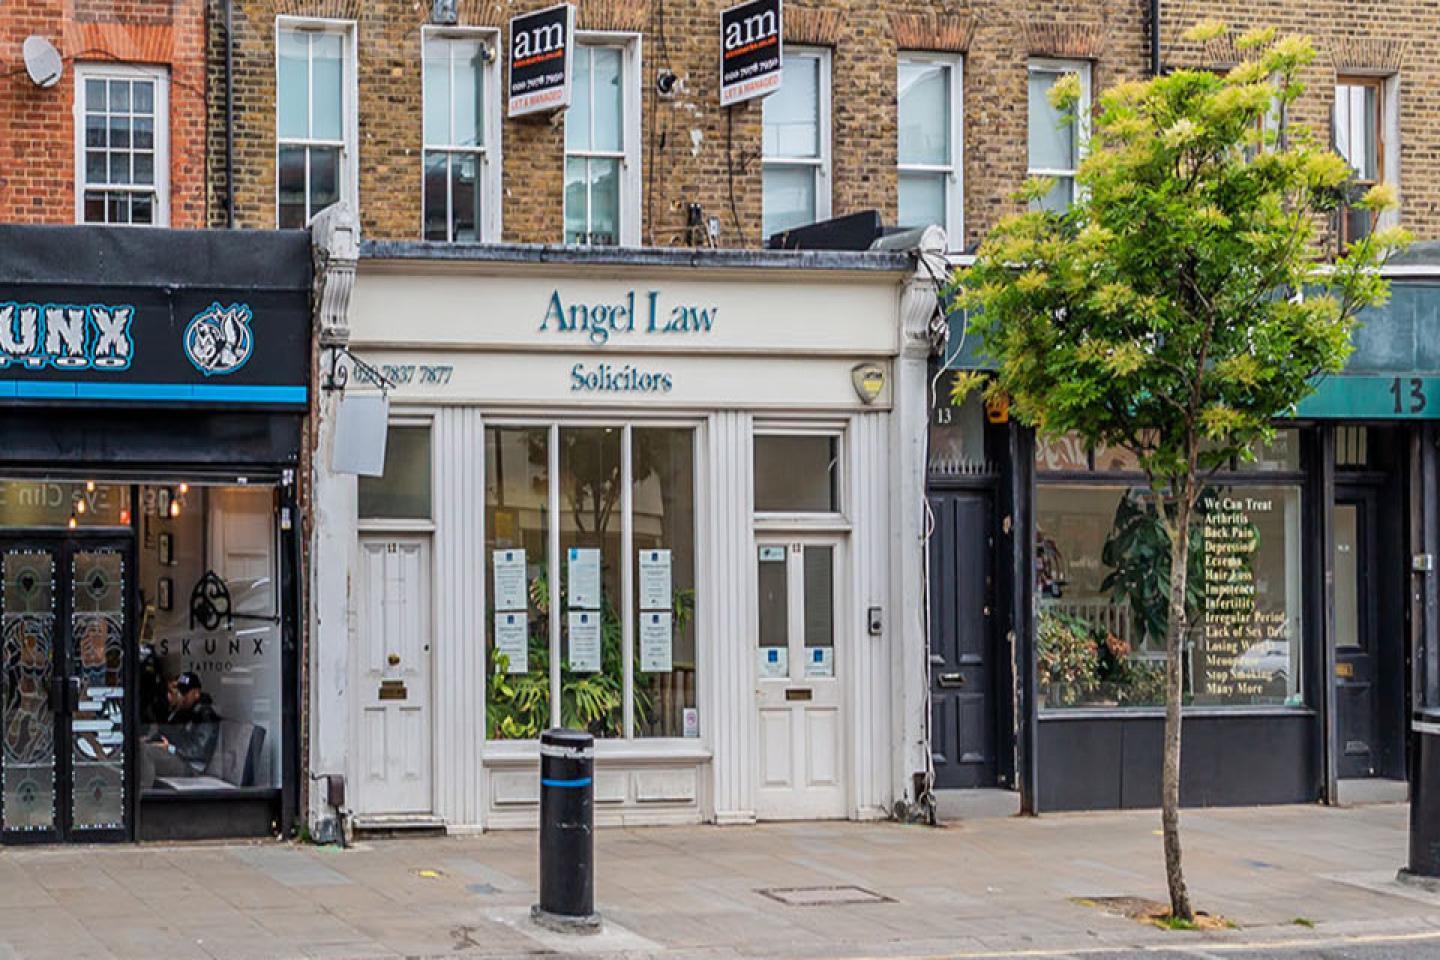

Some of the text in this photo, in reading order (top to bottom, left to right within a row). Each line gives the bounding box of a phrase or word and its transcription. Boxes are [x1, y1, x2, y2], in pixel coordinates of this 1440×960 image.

[725, 9, 778, 50] am
[513, 22, 565, 59] am
[745, 74, 780, 94] MANAGED
[529, 89, 563, 106] MANAGED
[538, 287, 719, 345] Angel Law
[382, 365, 417, 385] 7837
[419, 365, 454, 385] 7877
[570, 363, 673, 392] Solicitors
[1390, 377, 1427, 415] 13
[938, 407, 952, 424] 13
[1204, 498, 1273, 511] We Can Treat
[1205, 512, 1249, 524] Arthritis
[1205, 526, 1254, 538] Back Pain
[1205, 569, 1228, 580] Hair
[1205, 597, 1255, 610] Infertility
[1205, 612, 1250, 626] Irregular
[1205, 626, 1230, 637] Lack
[1232, 626, 1243, 637] of
[159, 638, 264, 657] SKUNX
[1205, 640, 1238, 655] Losing
[1205, 670, 1229, 683] Stop
[1205, 683, 1263, 697] Many More
